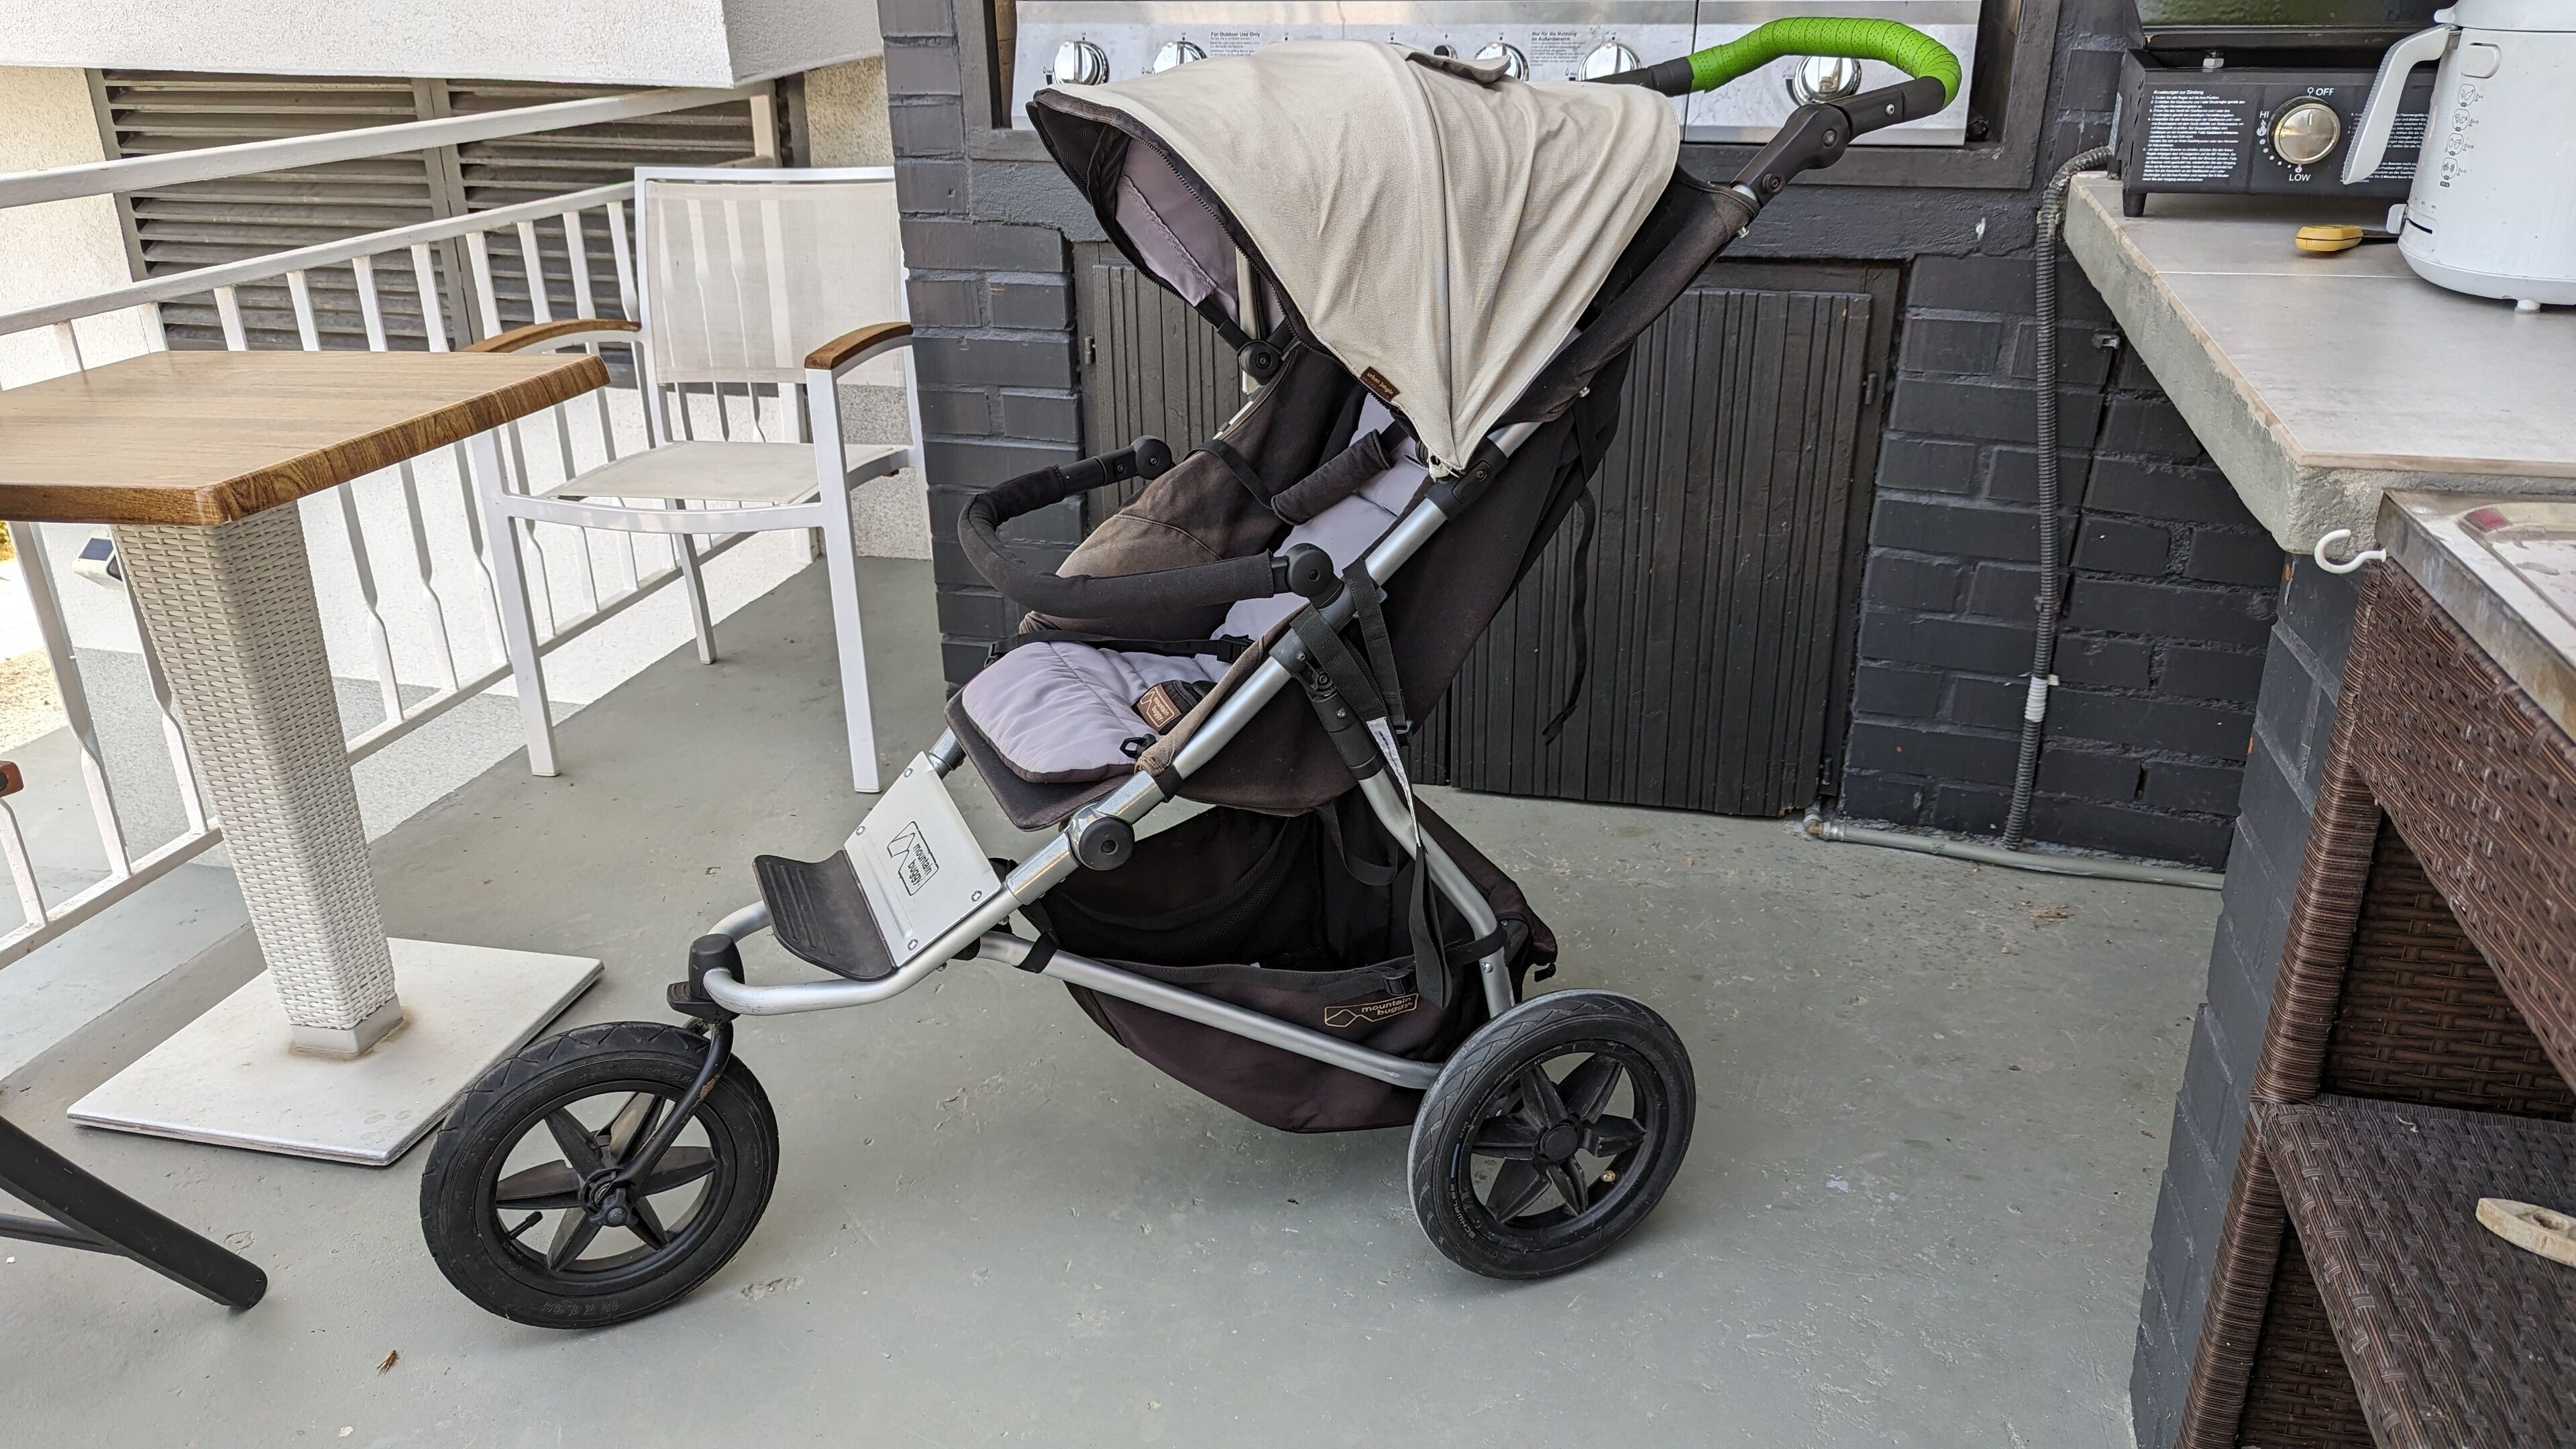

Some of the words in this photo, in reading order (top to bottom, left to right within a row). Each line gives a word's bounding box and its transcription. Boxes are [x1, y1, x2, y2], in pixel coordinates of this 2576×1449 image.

[2316, 88, 2334, 96] OFF
[1367, 372, 1381, 384] urban
[1151, 705, 1164, 721] buggy
[1153, 696, 1169, 716] mountain
[913, 843, 932, 875] mountain
[908, 859, 923, 885] buggy
[1361, 998, 1411, 1013] mountain
[1450, 1183, 1476, 1238] SCHWALBE
